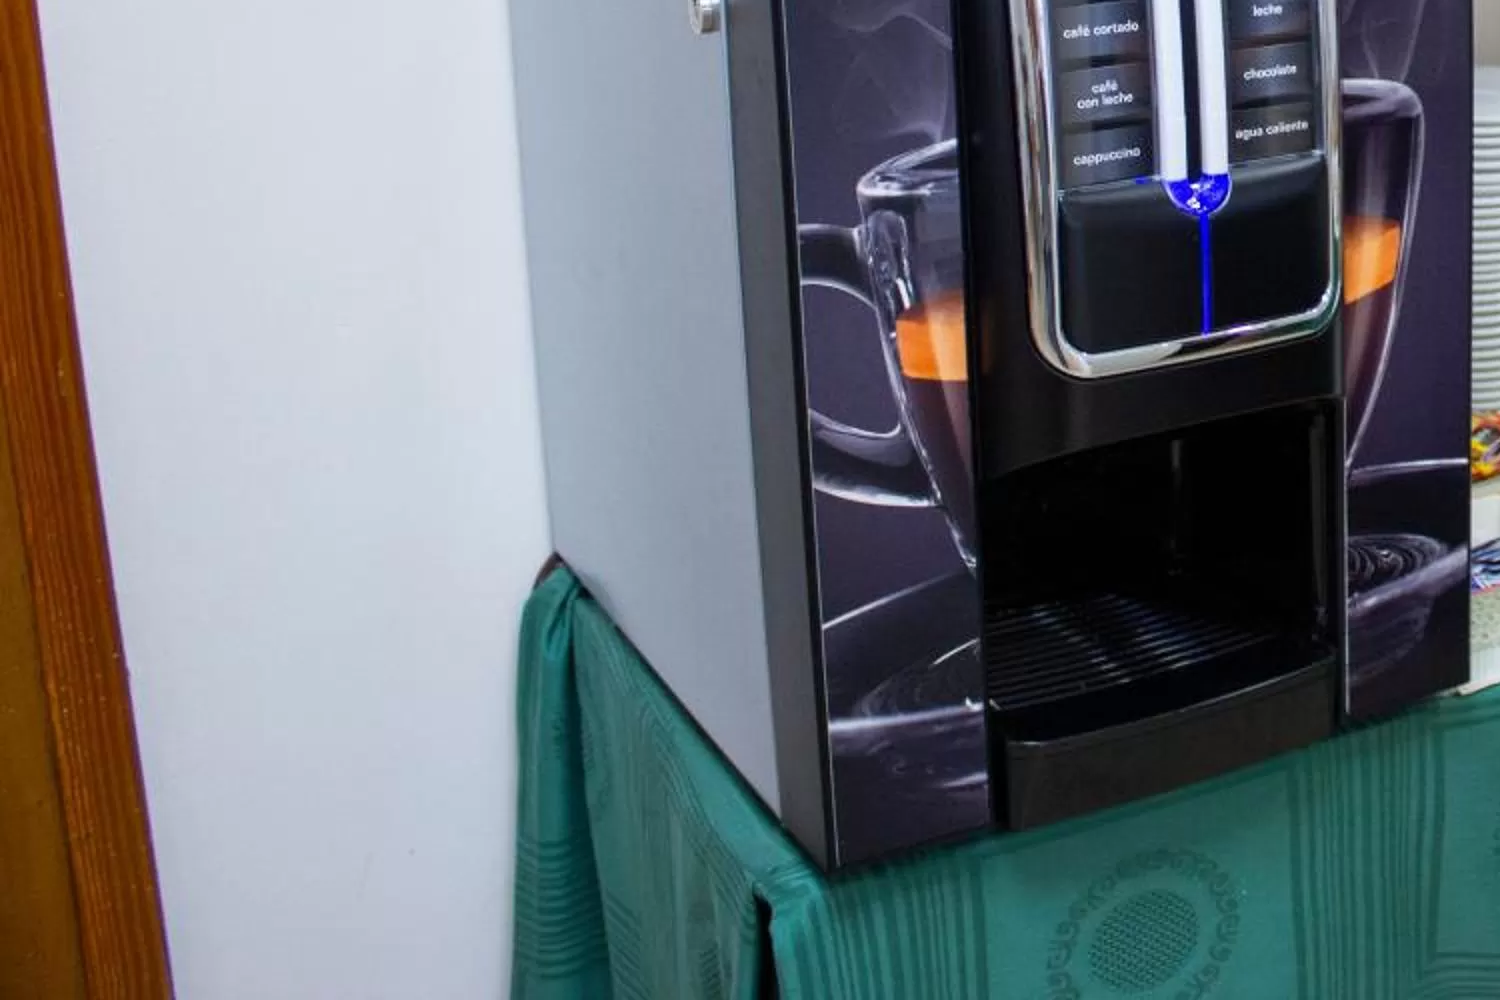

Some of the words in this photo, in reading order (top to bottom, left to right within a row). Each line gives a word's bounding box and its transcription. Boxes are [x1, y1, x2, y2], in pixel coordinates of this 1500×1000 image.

[1253, 3, 1283, 17] leche
[1063, 25, 1091, 40] café
[1093, 20, 1139, 37] cortado
[1243, 64, 1297, 81] chocolate
[1091, 80, 1118, 94] café
[1077, 97, 1100, 110] con
[1101, 91, 1134, 107] leche
[1235, 126, 1263, 141] agua
[1265, 119, 1309, 136] caliente
[1073, 146, 1141, 167] cappuccino
